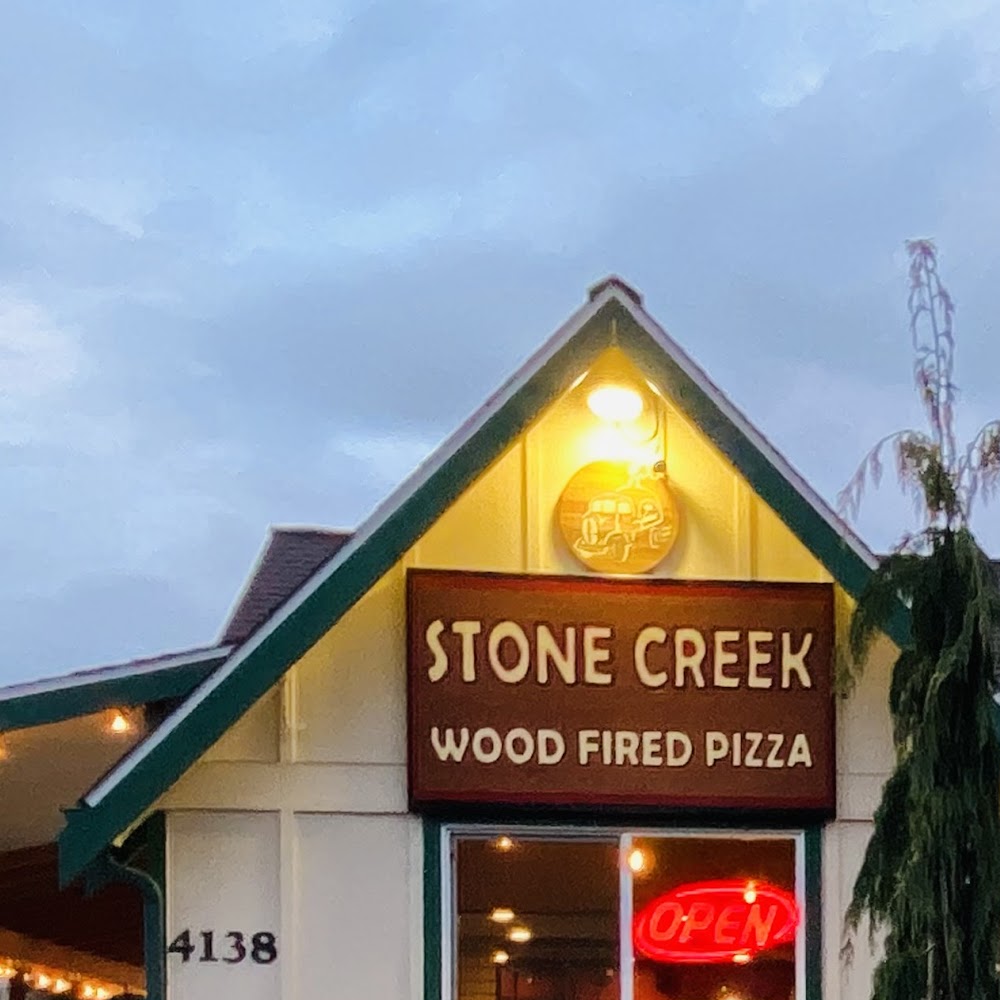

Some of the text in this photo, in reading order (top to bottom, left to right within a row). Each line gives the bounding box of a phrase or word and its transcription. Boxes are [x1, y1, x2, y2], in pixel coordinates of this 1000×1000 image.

[425, 619, 813, 689] STONE CREEK
[430, 726, 813, 768] WOOD FIRED PIZZA
[649, 901, 778, 947] OPEN
[167, 928, 278, 965] 4138
